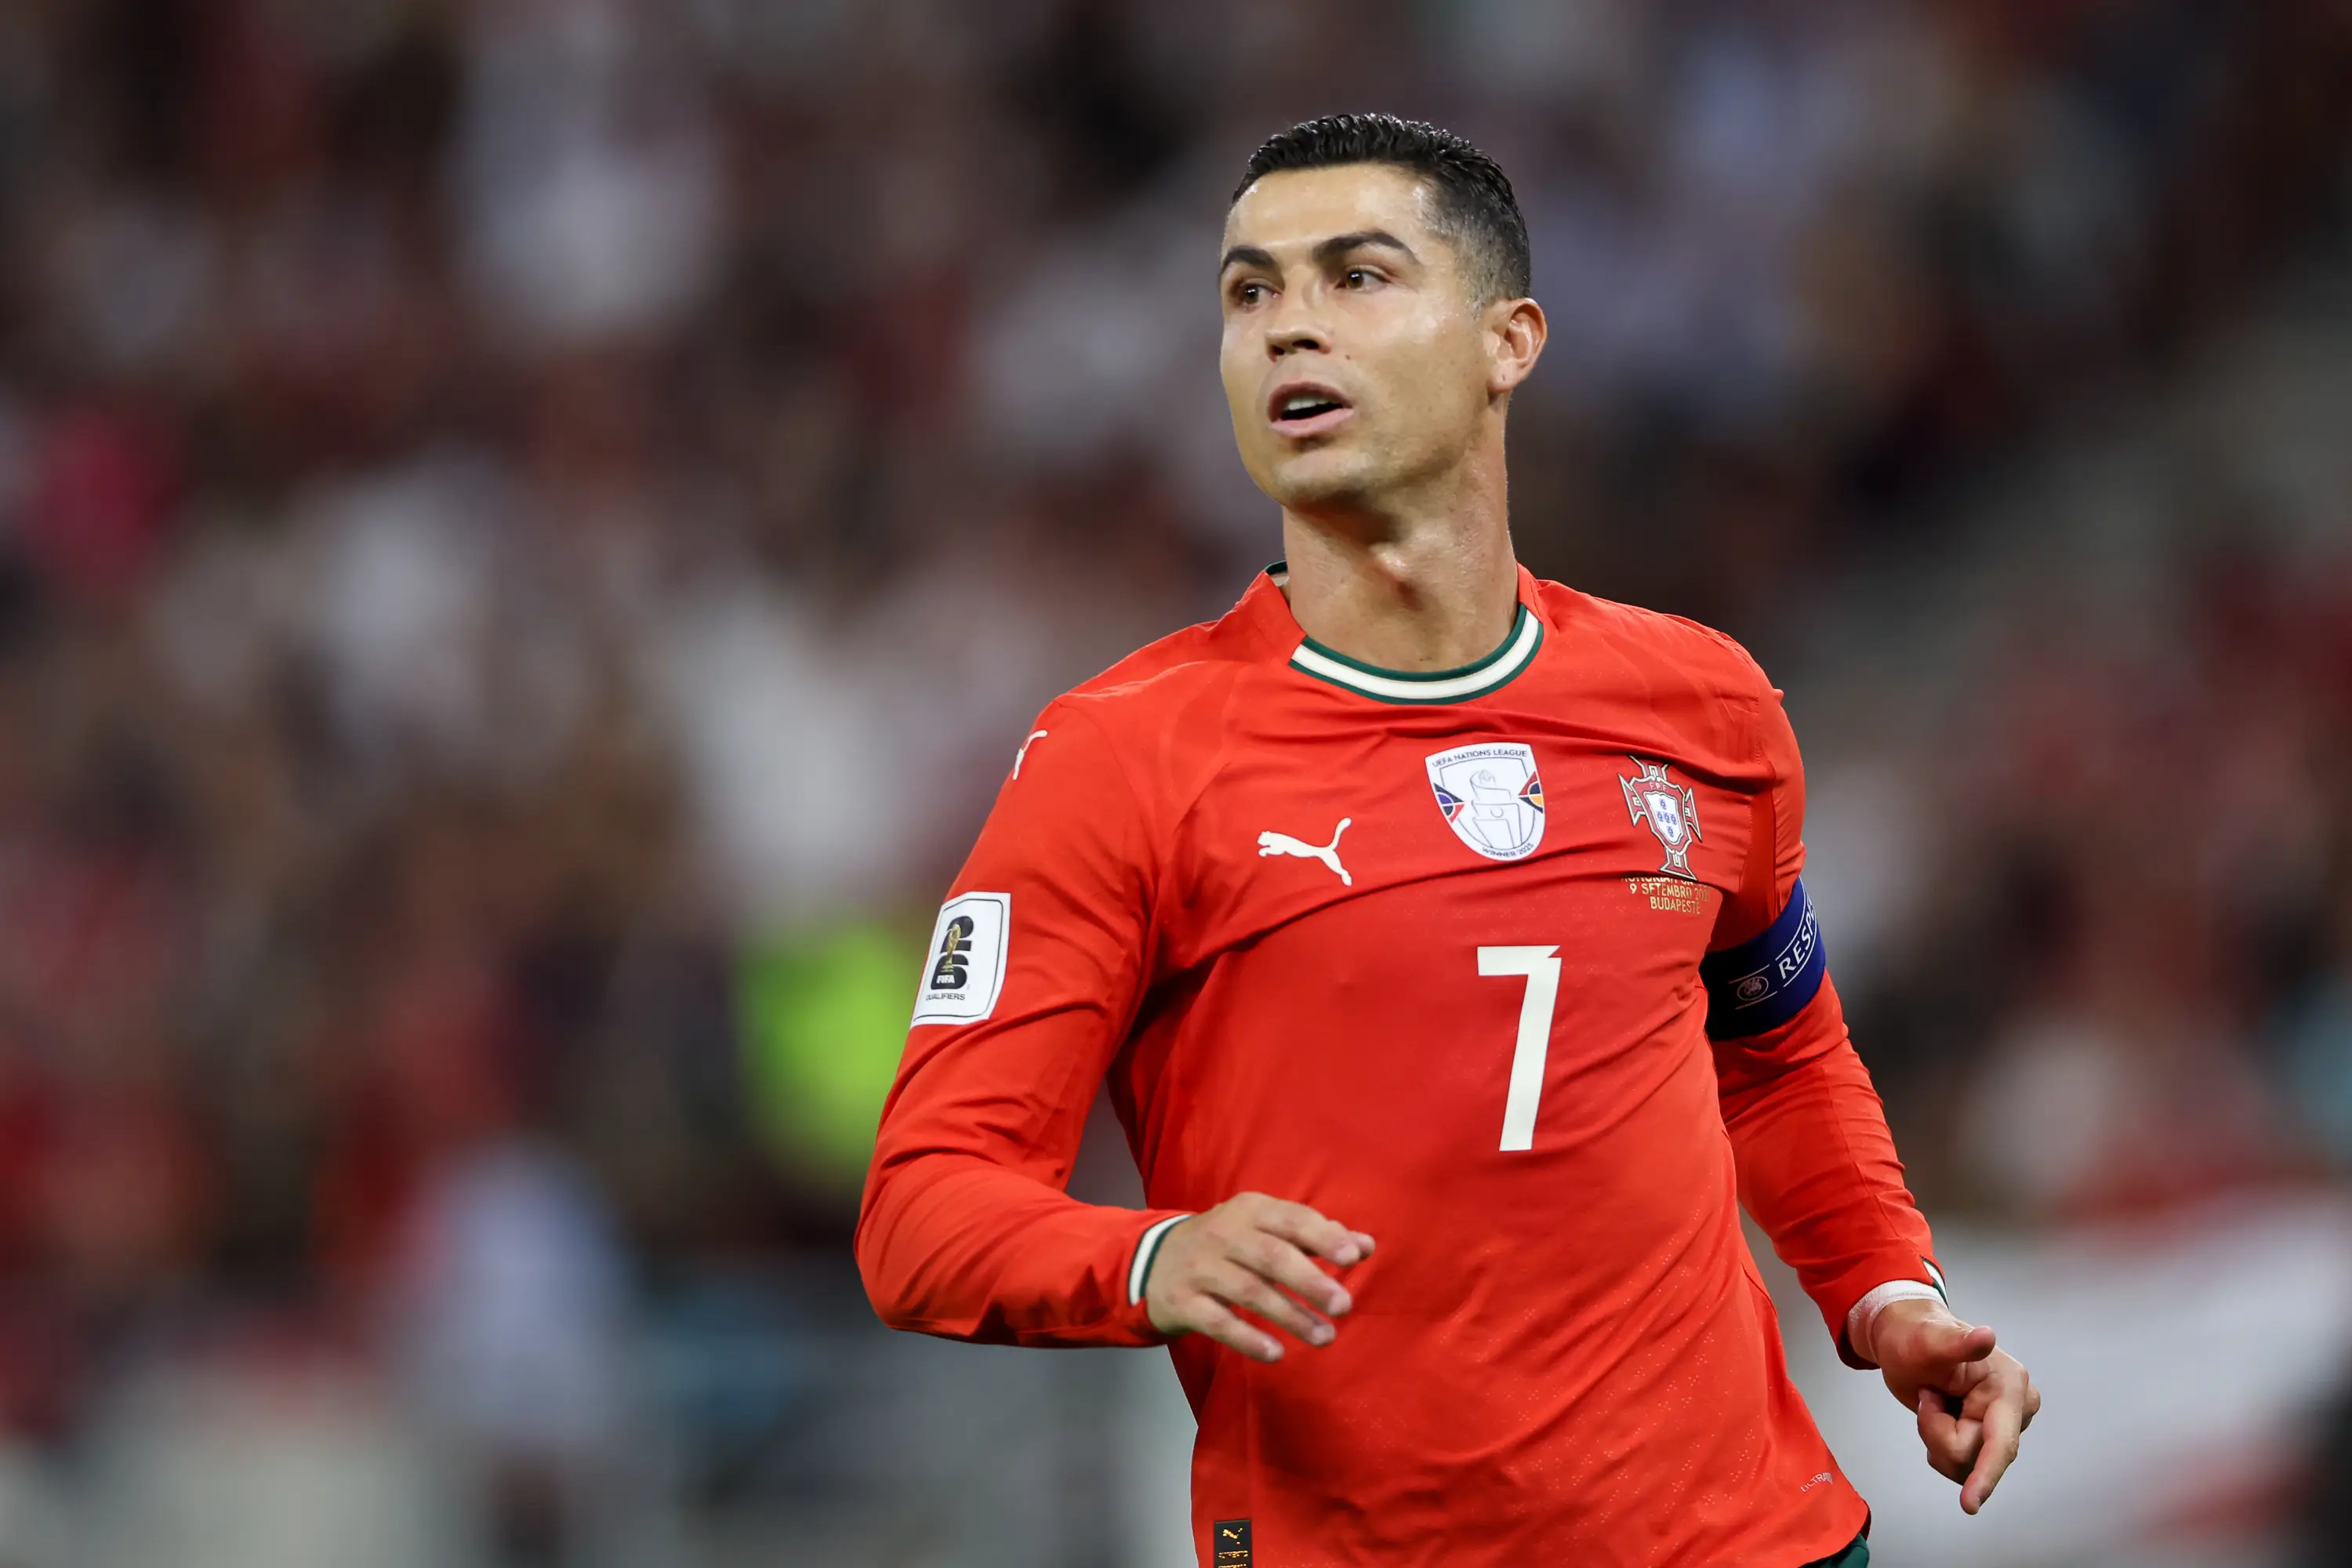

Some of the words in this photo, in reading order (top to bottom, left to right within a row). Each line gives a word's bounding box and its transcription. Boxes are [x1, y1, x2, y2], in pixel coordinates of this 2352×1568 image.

[1432, 756, 1452, 768] UEFA
[1454, 749, 1491, 760] NATIONS
[1493, 749, 1527, 757] LEAGUE
[1483, 847, 1515, 857] WINNER
[1629, 883, 1637, 894] 9
[1641, 883, 1693, 899] SETEMBRO
[1650, 896, 1700, 914] BUDAPESTE
[936, 975, 956, 984] FIFA
[926, 993, 965, 1001] QUALIFIERS
[1477, 946, 1562, 1151] 7
